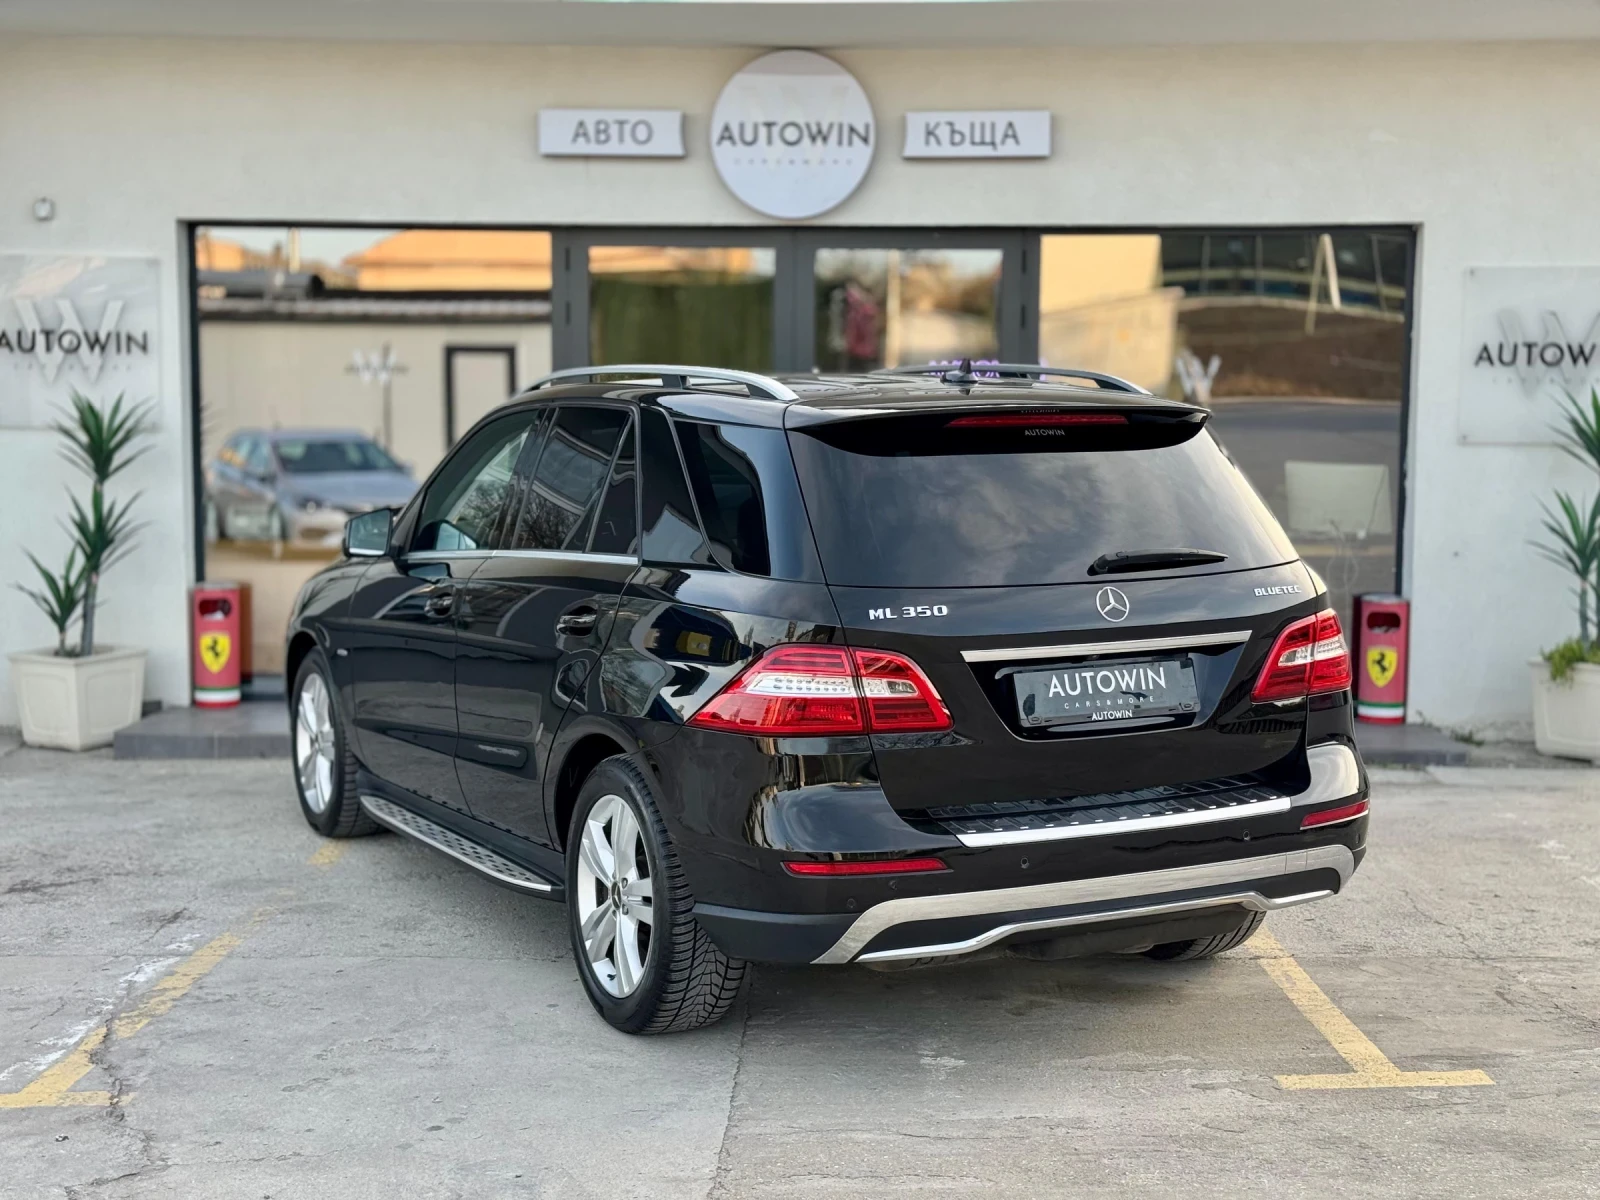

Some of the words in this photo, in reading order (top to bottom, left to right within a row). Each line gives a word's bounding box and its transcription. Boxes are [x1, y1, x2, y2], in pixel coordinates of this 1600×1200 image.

[571, 119, 654, 145] АВТО
[715, 121, 870, 147] AUTOWIN
[924, 120, 1021, 150] КЪЩА
[1024, 428, 1066, 437] AUTOWIN
[1254, 584, 1303, 597] BLUETEC
[868, 606, 898, 621] ML
[902, 604, 948, 619] 350
[1048, 666, 1167, 698] AUTOWIN
[1091, 709, 1133, 722] AUTOWIN
